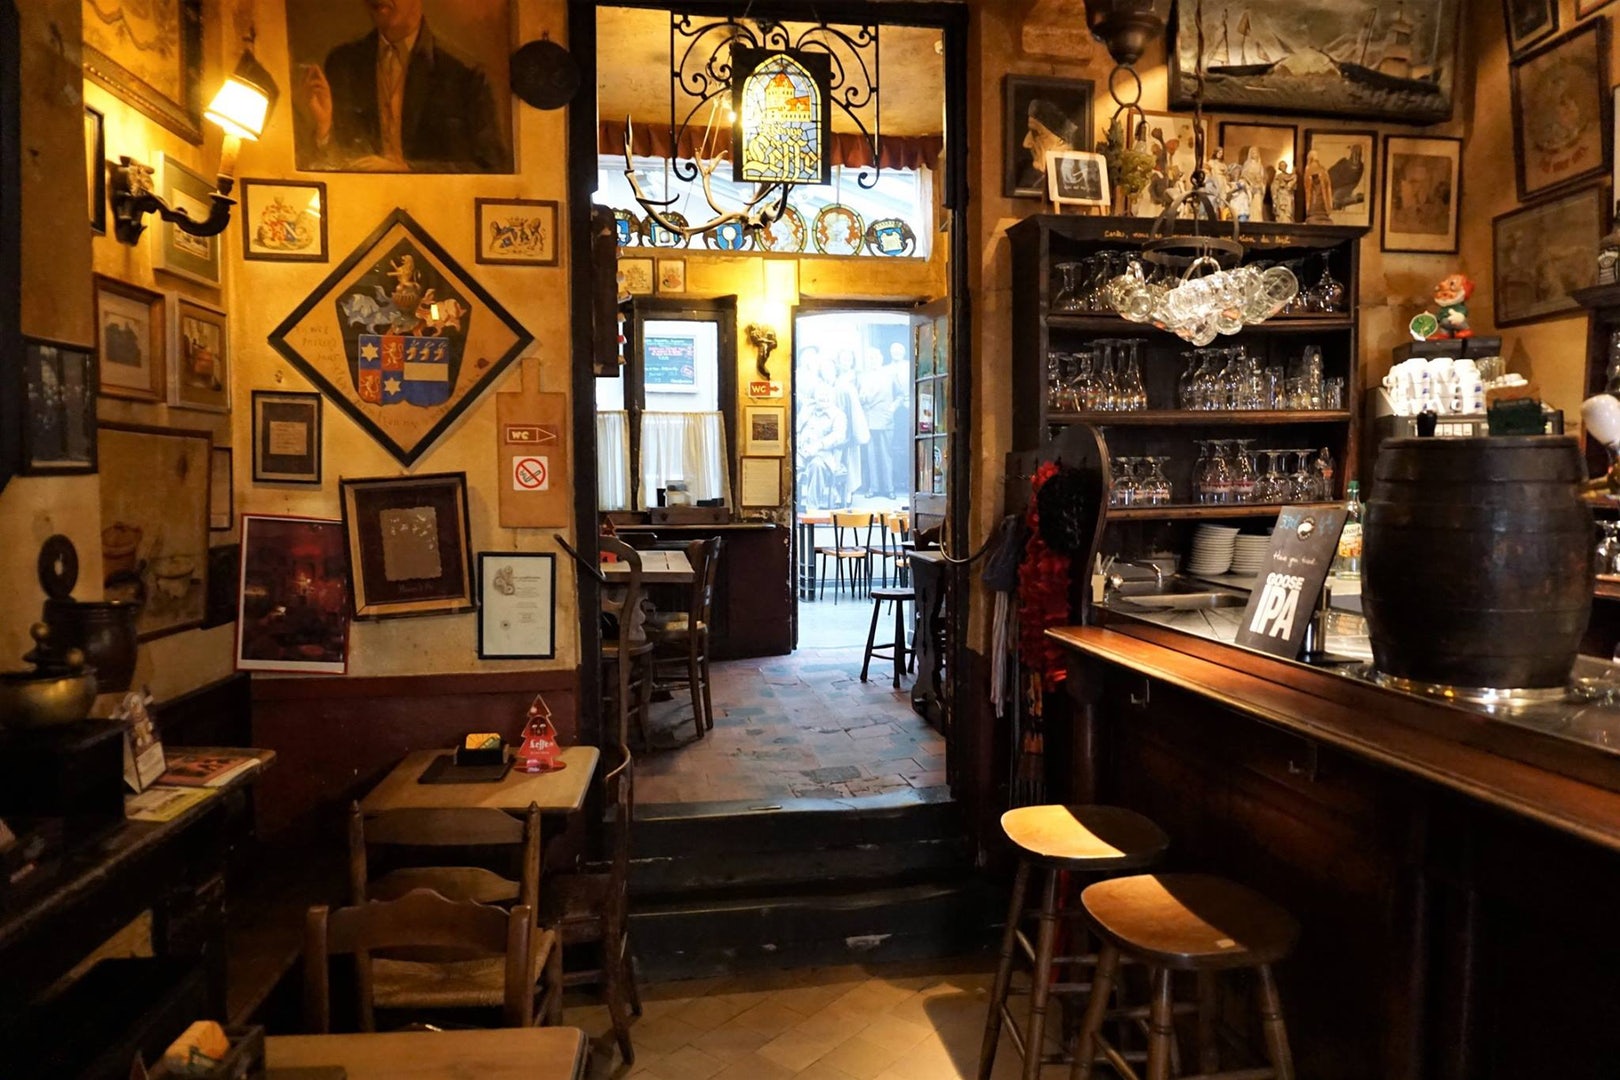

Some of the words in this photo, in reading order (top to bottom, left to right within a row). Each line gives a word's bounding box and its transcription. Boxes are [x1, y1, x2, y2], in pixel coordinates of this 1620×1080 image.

[743, 133, 818, 181] Leffe
[751, 385, 766, 393] WC
[511, 431, 529, 440] WC
[1267, 572, 1305, 591] GOOSE
[1249, 584, 1301, 642] IPA
[529, 739, 549, 751] Leffe
